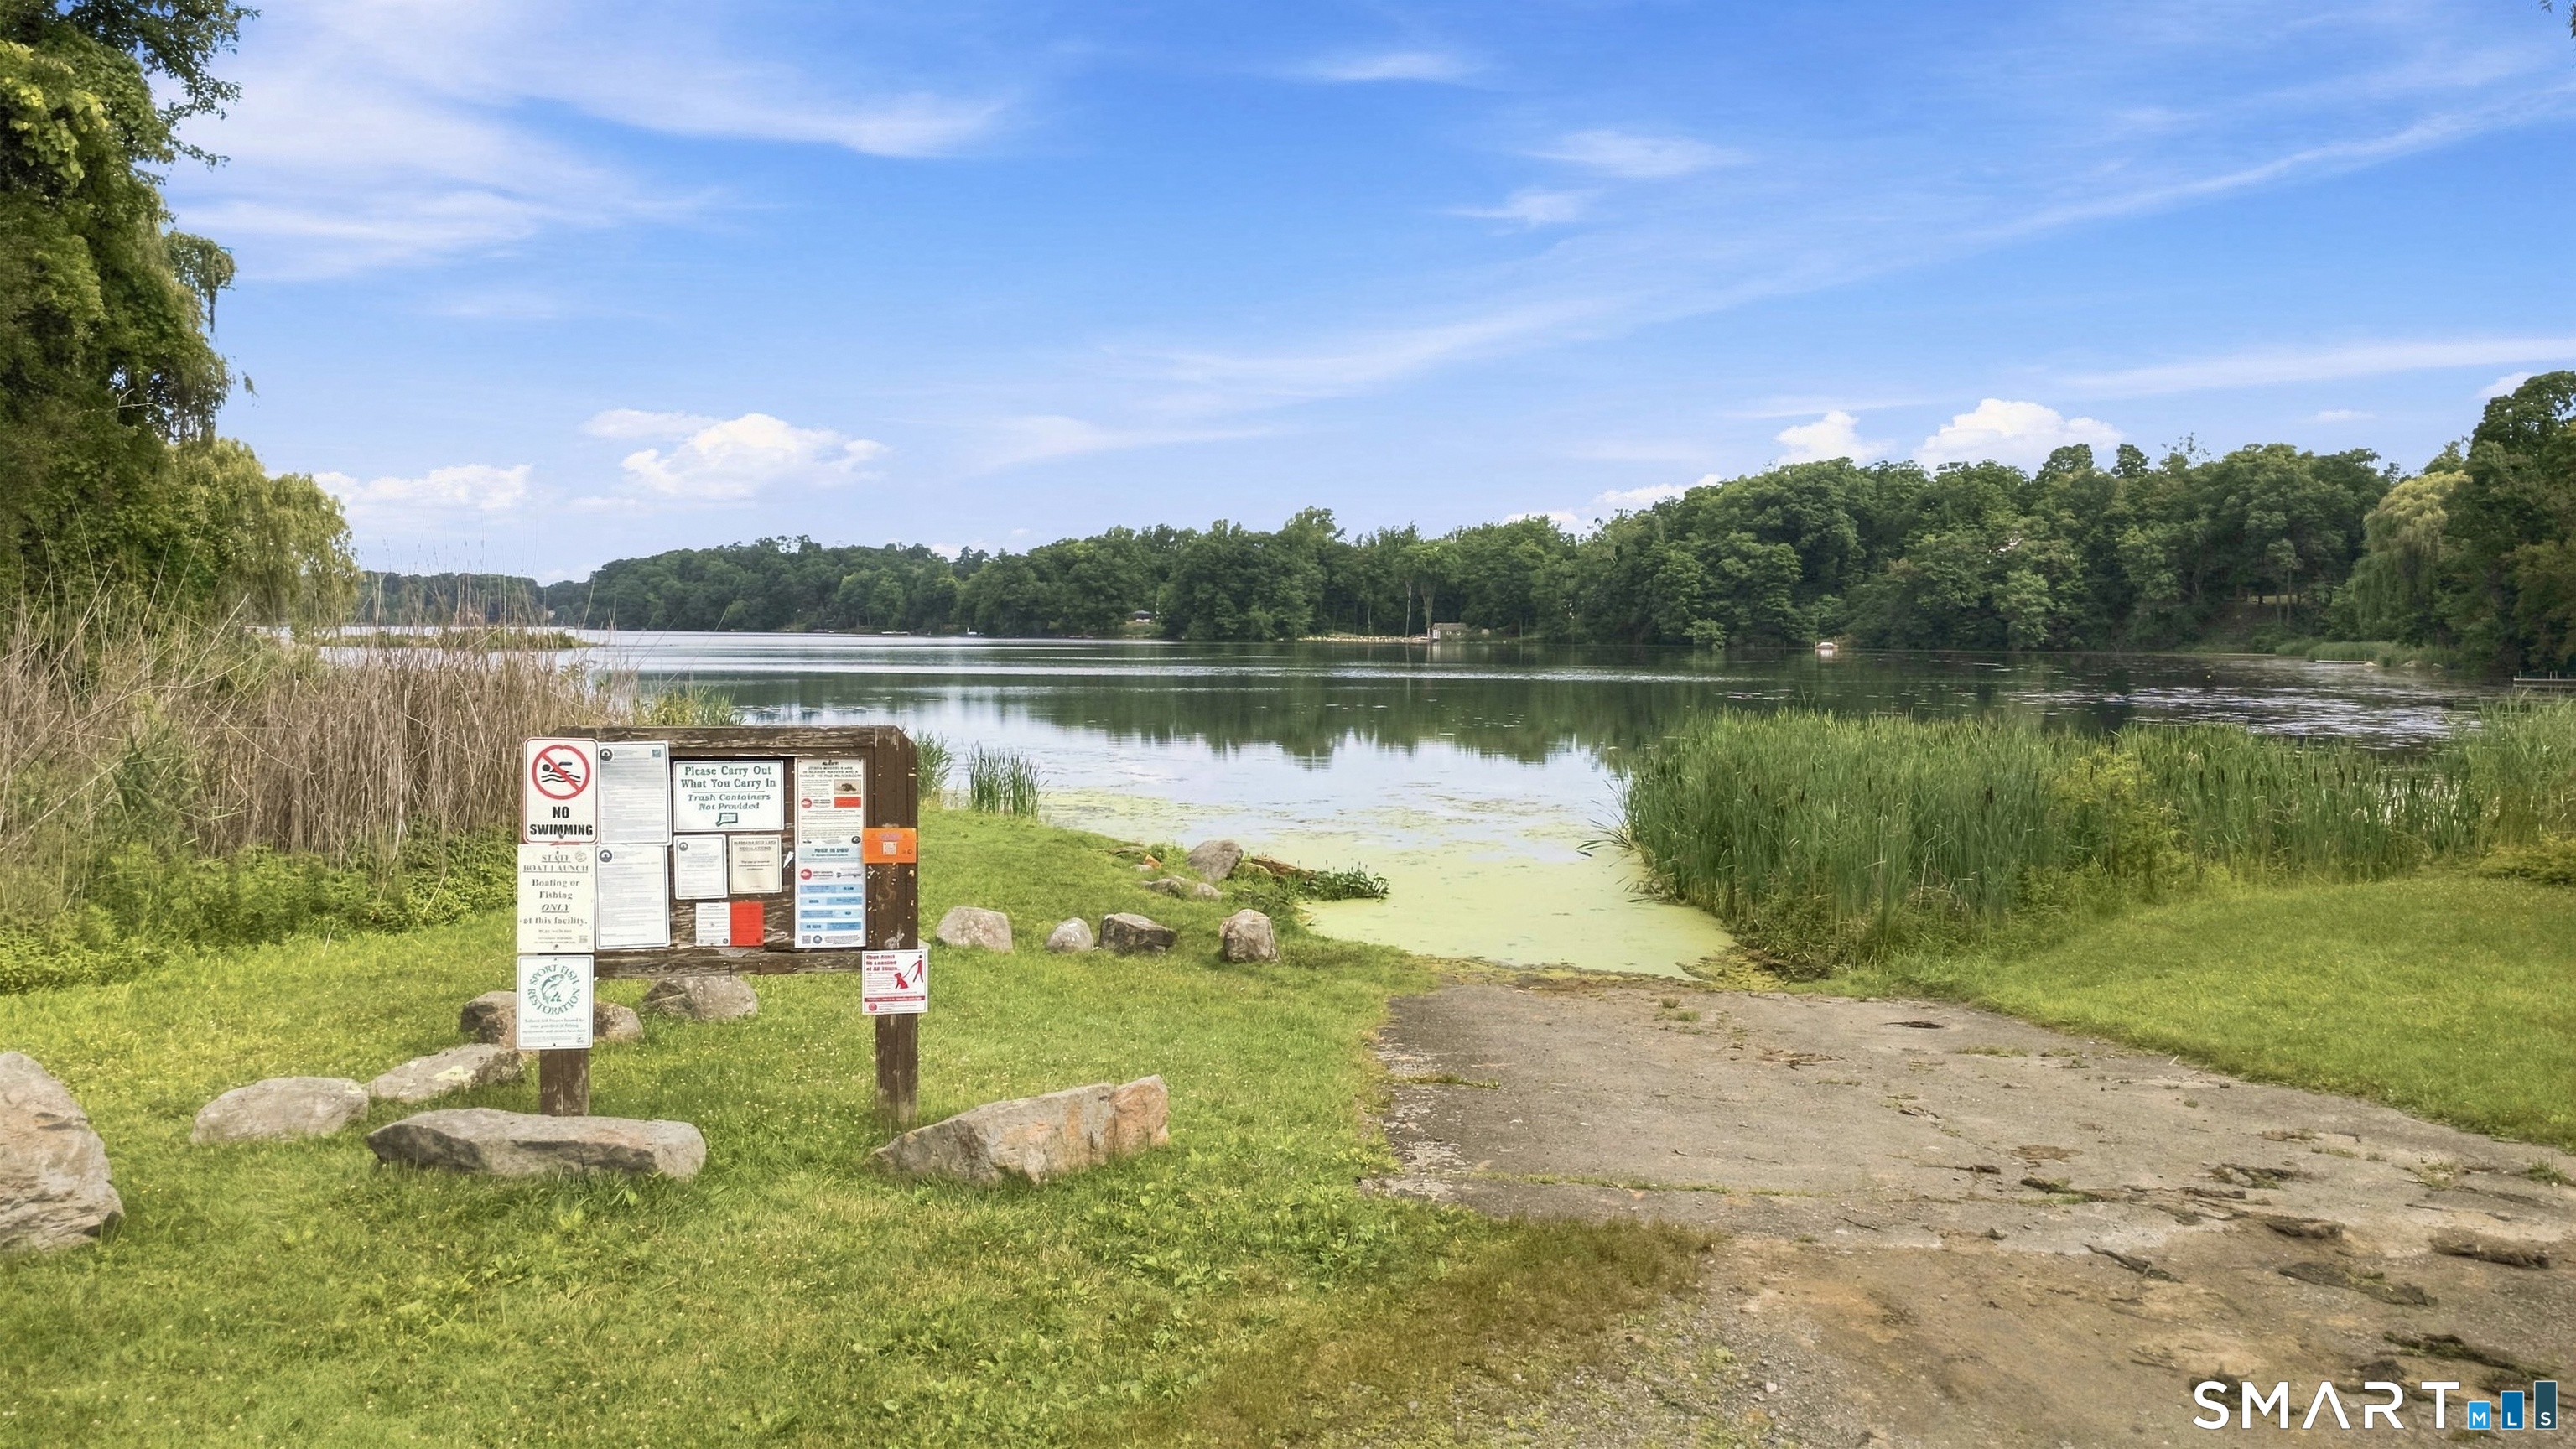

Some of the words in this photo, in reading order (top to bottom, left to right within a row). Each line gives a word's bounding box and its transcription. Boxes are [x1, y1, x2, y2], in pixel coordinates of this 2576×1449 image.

[685, 766, 716, 776] Please
[721, 766, 749, 777] Carry
[753, 766, 771, 775] Out
[681, 779, 706, 788] What
[710, 779, 730, 787] You
[734, 778, 761, 789] Carry
[766, 778, 776, 787] In
[553, 806, 569, 818] NO
[529, 823, 593, 836] SWIMMING
[532, 879, 568, 887] Boating
[539, 891, 573, 900] Fishing
[554, 917, 588, 926] facility.
[529, 964, 558, 985] SPORT
[560, 965, 579, 984] FISH
[527, 988, 580, 1015] RESTORATION
